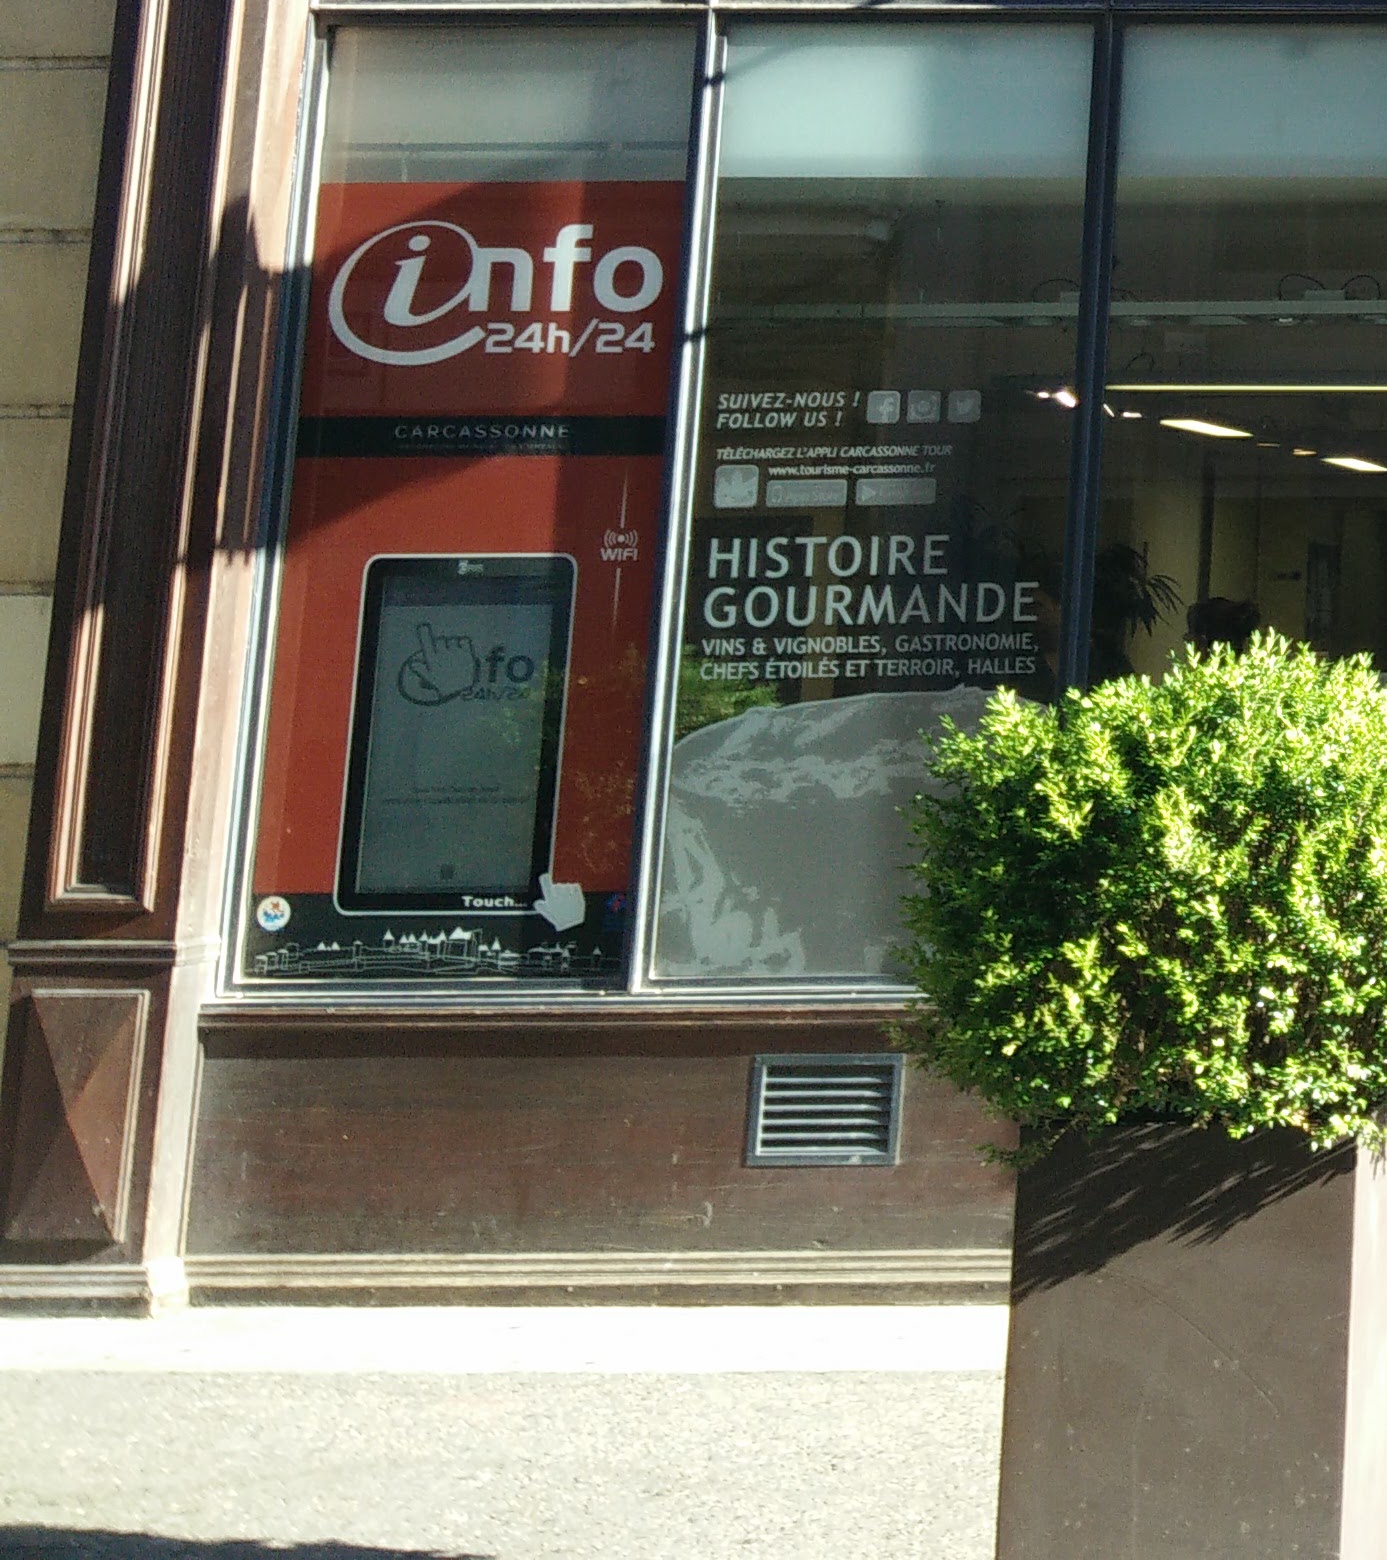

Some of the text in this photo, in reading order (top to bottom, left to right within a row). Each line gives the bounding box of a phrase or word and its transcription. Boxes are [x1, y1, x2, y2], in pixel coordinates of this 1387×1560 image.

[484, 318, 656, 357] 24h/24
[718, 391, 861, 410] SUIVEZ-NOUS !
[717, 411, 843, 429] FOLLOW US !
[394, 423, 571, 440] CARCASSONNE
[716, 444, 953, 460] TÉLÉCHARGEZ L'APPLI CARCASSONNE TOUR
[600, 547, 638, 562] WIFI
[708, 534, 951, 579] HISTOIRE
[703, 581, 1040, 629] GOURMANDE
[702, 633, 1040, 656] VINS & VIGNOBLES, GASTRONOMIE,
[700, 652, 1037, 681] CHEFS ÉTOILÉS ET TERROIR, HALLES
